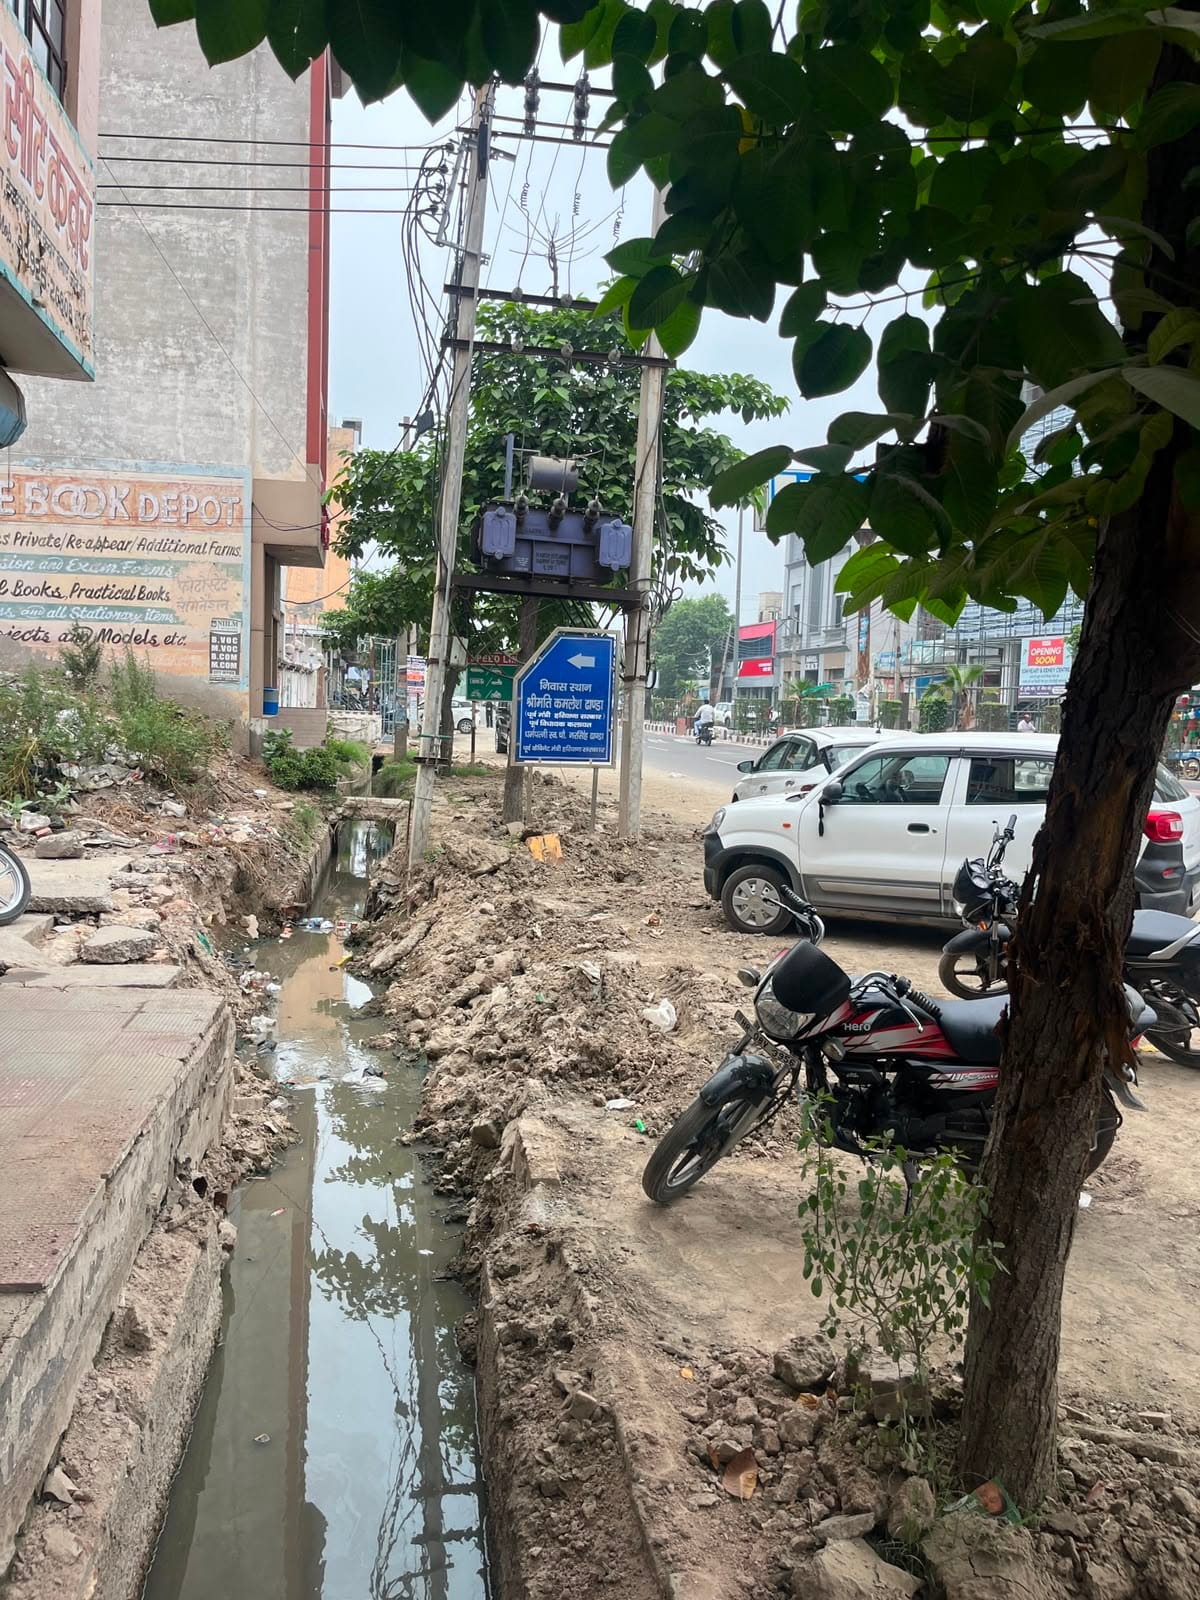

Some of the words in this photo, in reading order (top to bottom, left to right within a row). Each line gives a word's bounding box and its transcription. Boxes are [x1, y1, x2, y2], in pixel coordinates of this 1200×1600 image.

[24, 480, 131, 521] BOOK
[138, 491, 242, 527] DEPOT
[69, 582, 136, 601] Practical
[137, 585, 171, 602] Books
[46, 605, 67, 619] all
[211, 636, 238, 644] B.VOC
[211, 644, 238, 653] M.VOC
[1030, 646, 1062, 656] OPENING
[211, 653, 238, 661] B.COM
[1035, 655, 1057, 665] SOON
[211, 661, 238, 669] M.COM
[539, 678, 568, 692] निवास
[569, 682, 593, 693] स्थान
[842, 1022, 872, 1032] Hero
